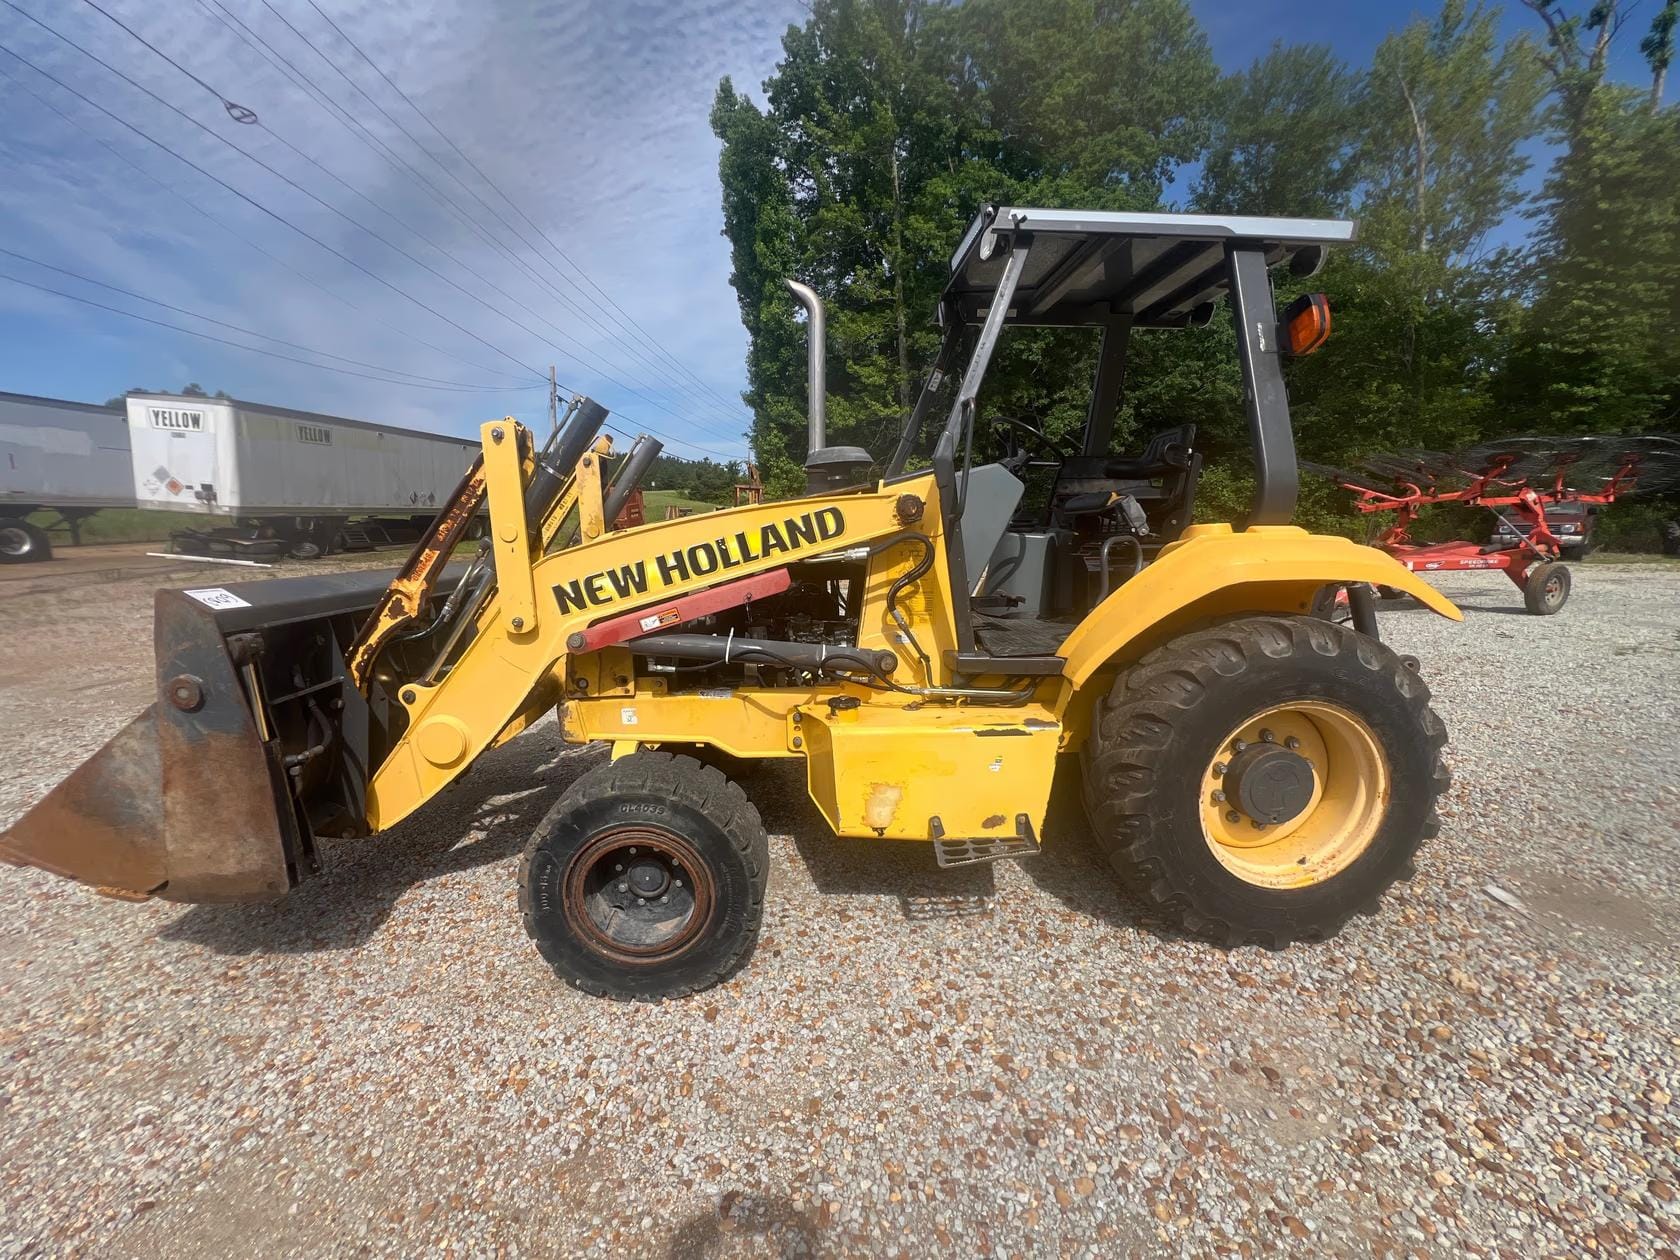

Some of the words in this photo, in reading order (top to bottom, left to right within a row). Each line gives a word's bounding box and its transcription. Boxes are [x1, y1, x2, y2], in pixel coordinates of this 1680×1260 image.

[152, 409, 201, 429] YELLOW
[298, 426, 331, 443] YELLOW
[551, 561, 648, 616] NEW
[655, 506, 846, 586] HOLLAND
